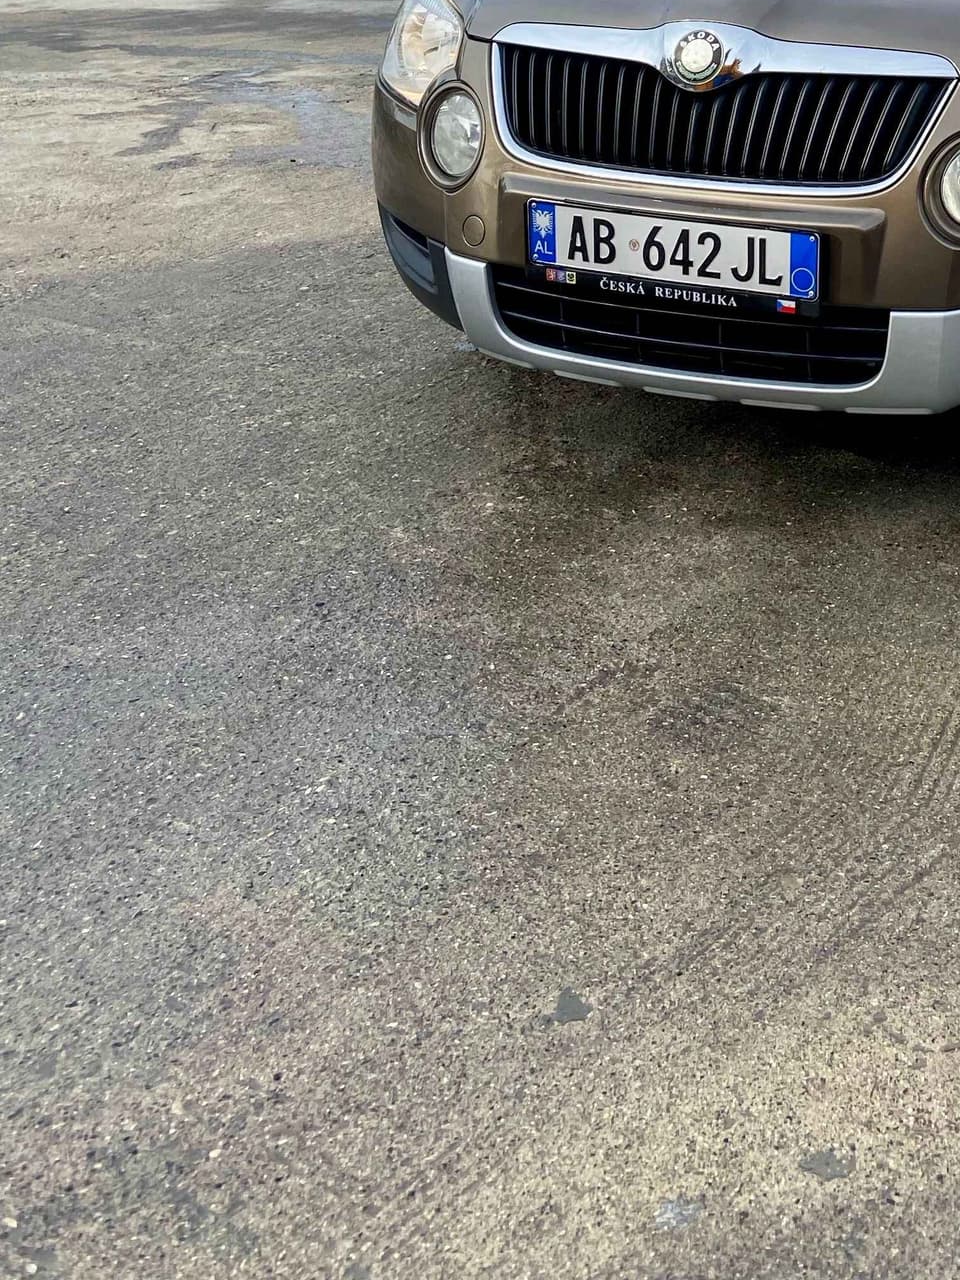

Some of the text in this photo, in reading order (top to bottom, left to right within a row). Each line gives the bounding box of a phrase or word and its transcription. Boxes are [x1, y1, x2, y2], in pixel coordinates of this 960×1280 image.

[534, 241, 553, 255] AL
[567, 215, 783, 287] AB 642 JL
[599, 276, 646, 295] ČESKÁ
[655, 286, 738, 308] REPUBLIKA
